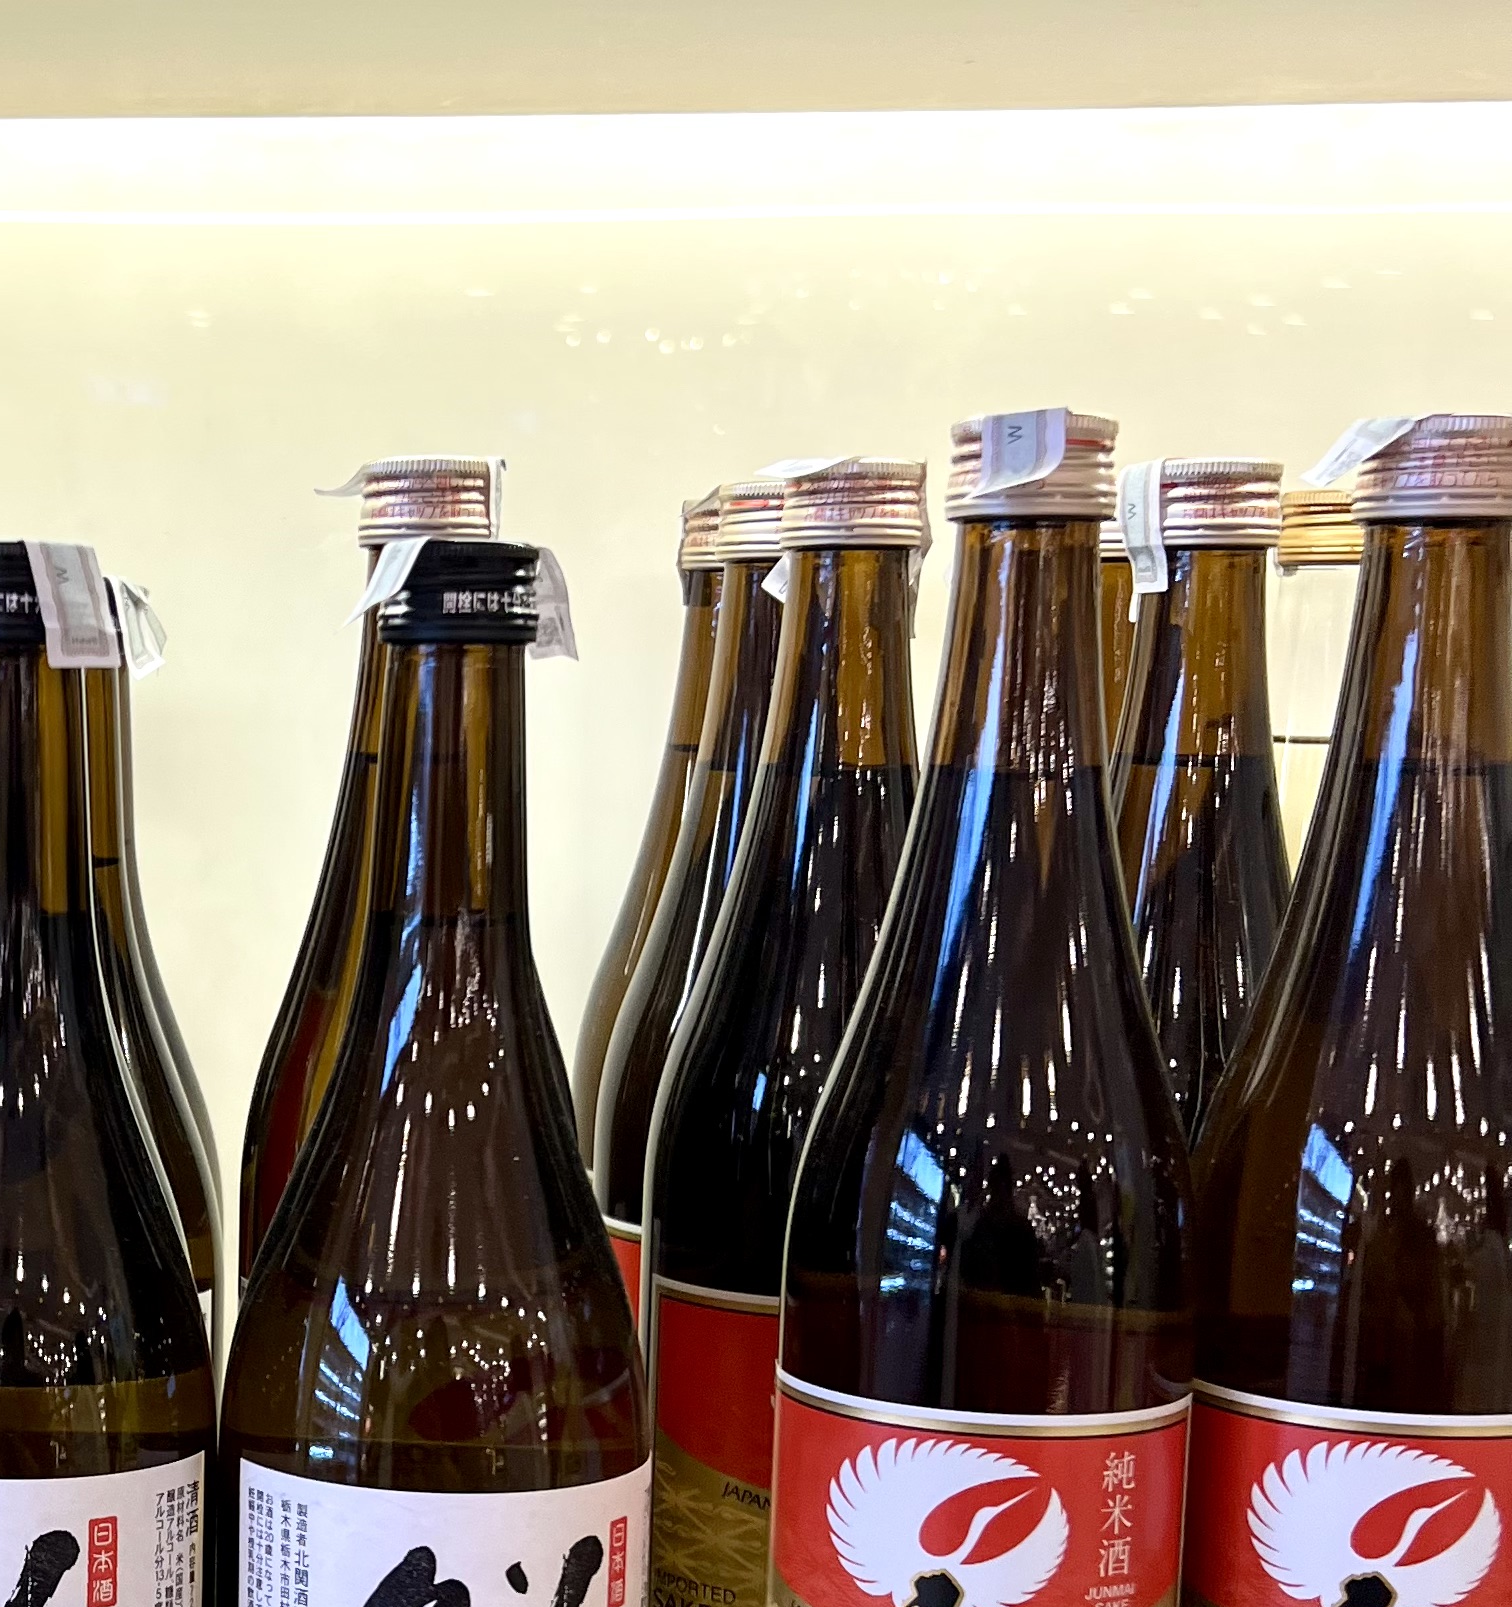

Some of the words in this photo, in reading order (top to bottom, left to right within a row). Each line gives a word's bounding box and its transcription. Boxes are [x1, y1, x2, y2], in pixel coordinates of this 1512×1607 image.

[1098, 1451, 1136, 1577] 純米酒
[90, 1520, 116, 1606] 日本酒
[1084, 1582, 1136, 1601] JUNMAI
